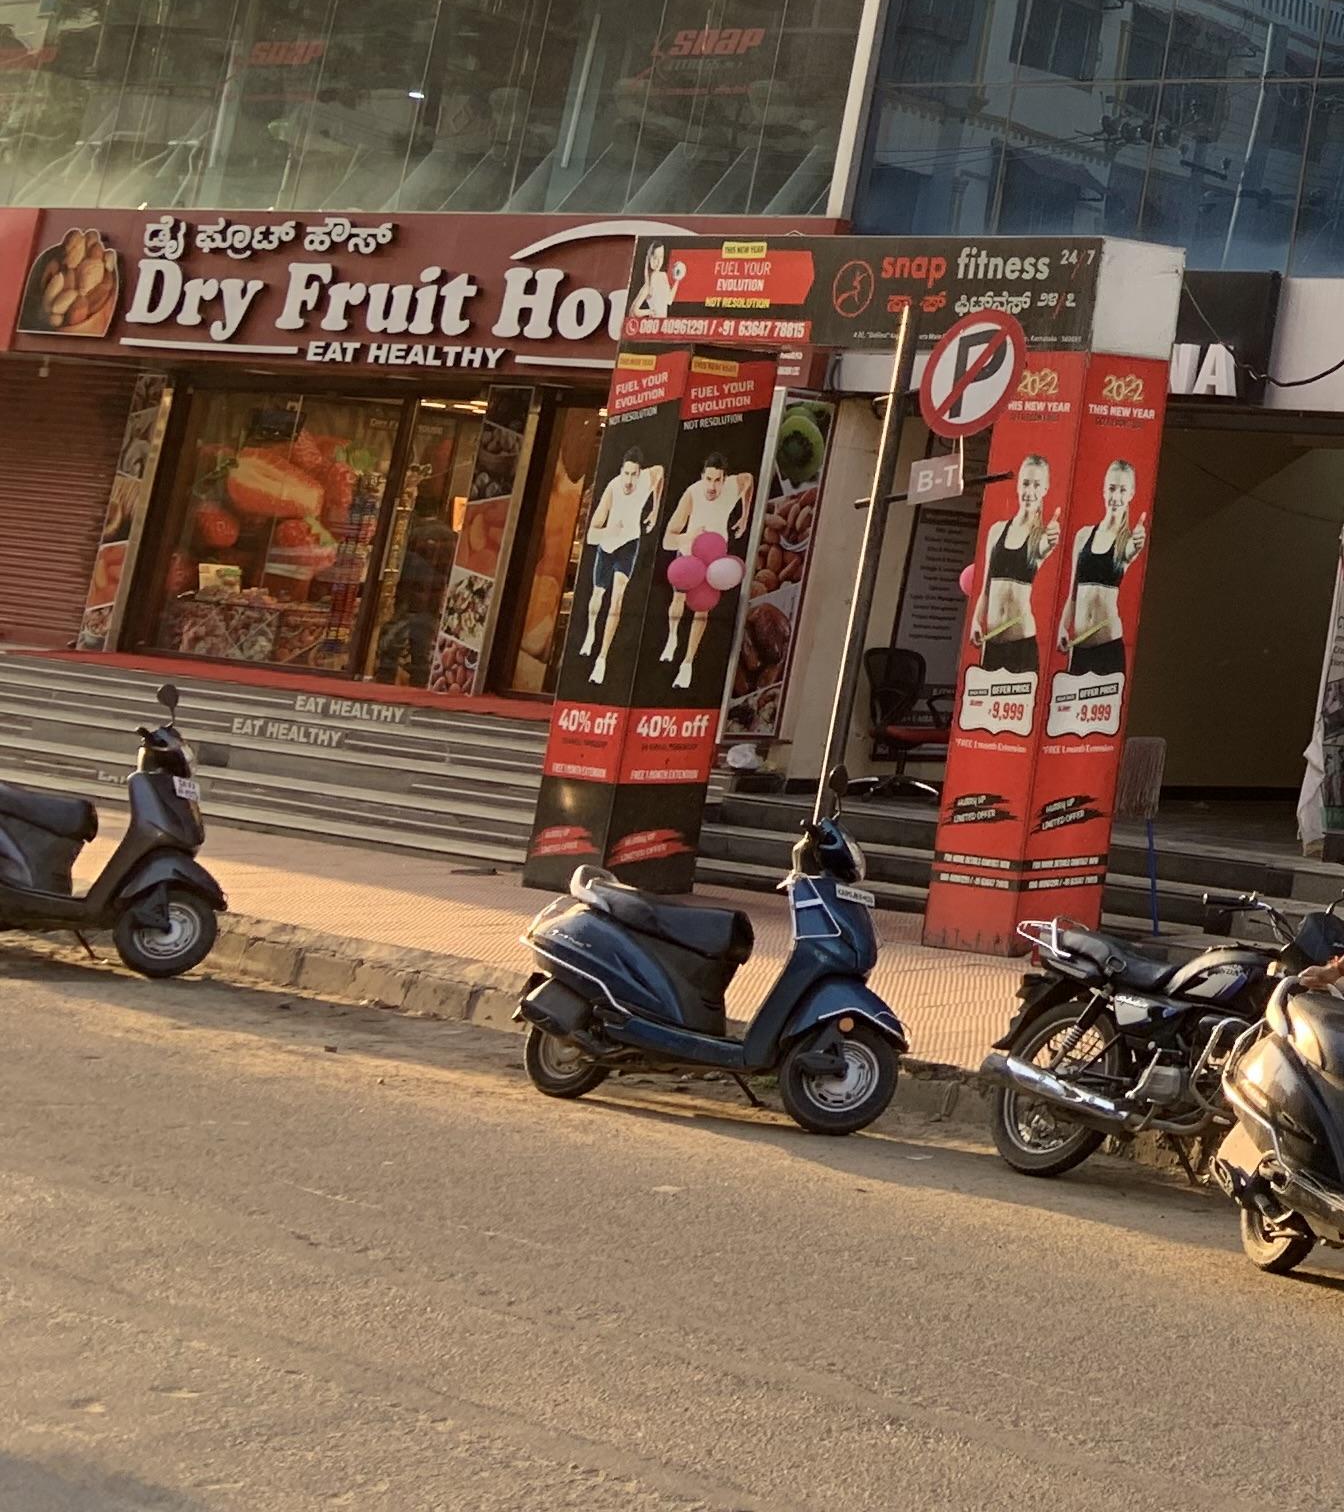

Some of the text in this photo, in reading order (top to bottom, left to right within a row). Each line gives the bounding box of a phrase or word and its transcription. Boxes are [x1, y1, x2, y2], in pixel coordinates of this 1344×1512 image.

[714, 262, 771, 276] FUEL YOUR
[880, 255, 947, 288] snap
[956, 246, 1050, 281] fitness
[716, 279, 765, 292] EVOLUTION
[126, 257, 265, 341] Dry
[275, 262, 485, 338] Fruit
[705, 297, 771, 309] NOT RESOLUTION
[639, 320, 658, 334] 080
[305, 340, 505, 369] EAT HEALTHY
[616, 371, 669, 395] FUEL YOUR
[691, 380, 755, 400] FUEL YOUR
[1018, 368, 1060, 396] 2022
[1102, 373, 1145, 402] 2022
[616, 388, 665, 409] EVOLUTION
[690, 396, 751, 414] EVOLUTION
[1025, 402, 1046, 412] NEW
[1047, 402, 1071, 413] YEAR
[608, 407, 658, 426] NOT RESOLUTION
[1088, 403, 1156, 419] THIS NEW YEAR
[683, 414, 743, 431] NOT RESOLUTION
[992, 683, 1030, 695] OFFER PRICE
[1079, 684, 1118, 699] OFFER PRICE
[294, 695, 407, 724] EAT HEALTHY
[558, 708, 619, 736] 40% off
[636, 714, 710, 738] 40% off
[231, 717, 342, 748] EAT HEALTHY
